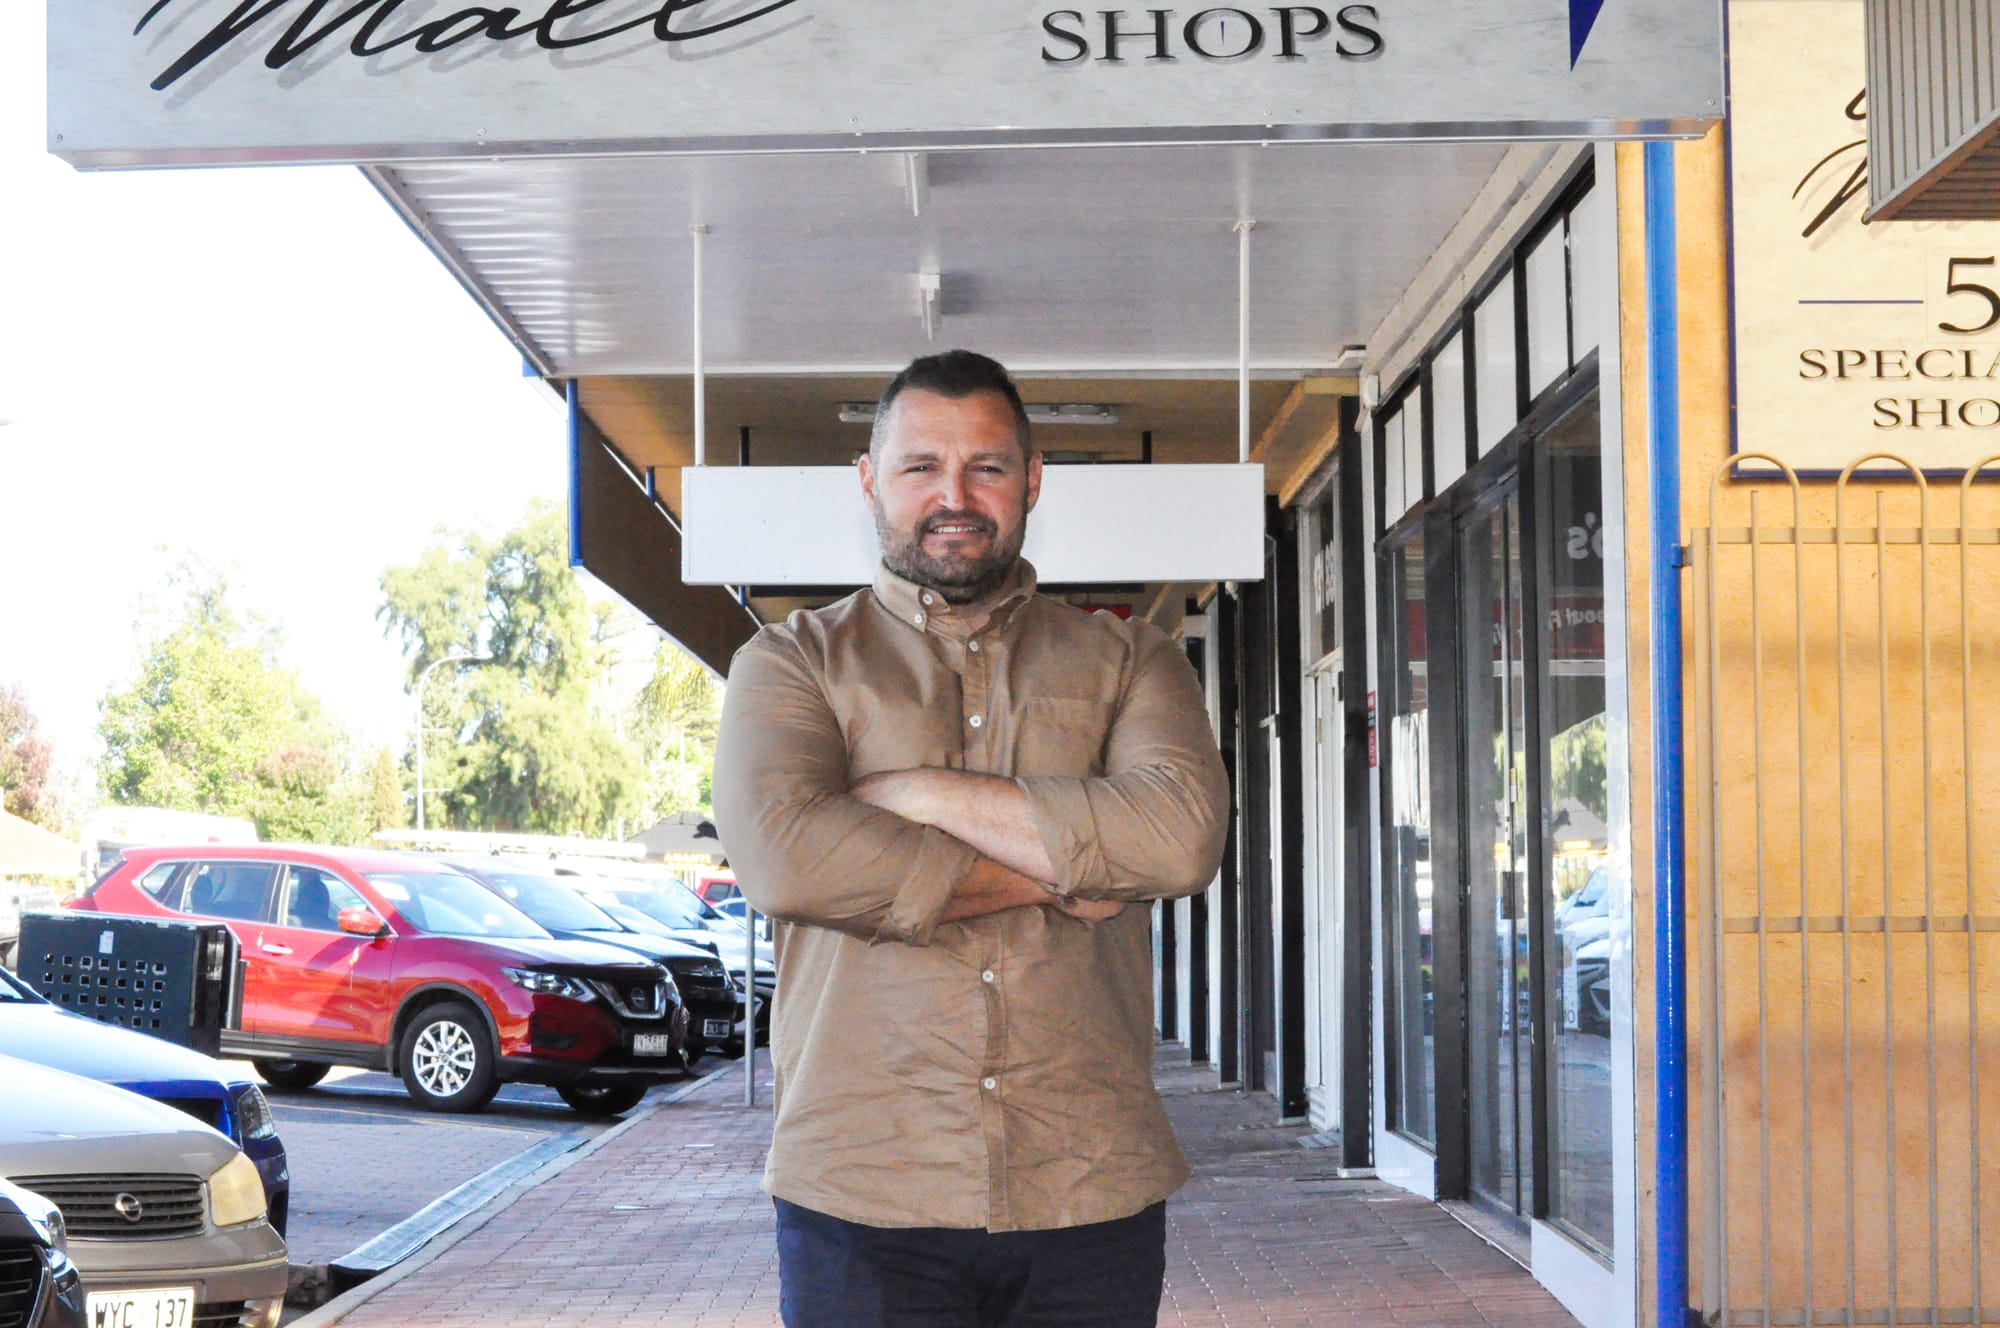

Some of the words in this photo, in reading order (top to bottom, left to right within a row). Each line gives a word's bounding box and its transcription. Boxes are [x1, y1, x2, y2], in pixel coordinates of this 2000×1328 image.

[1042, 5, 1382, 62] SHOPS
[95, 1301, 134, 1328] WYC
[156, 1298, 187, 1328] 137
